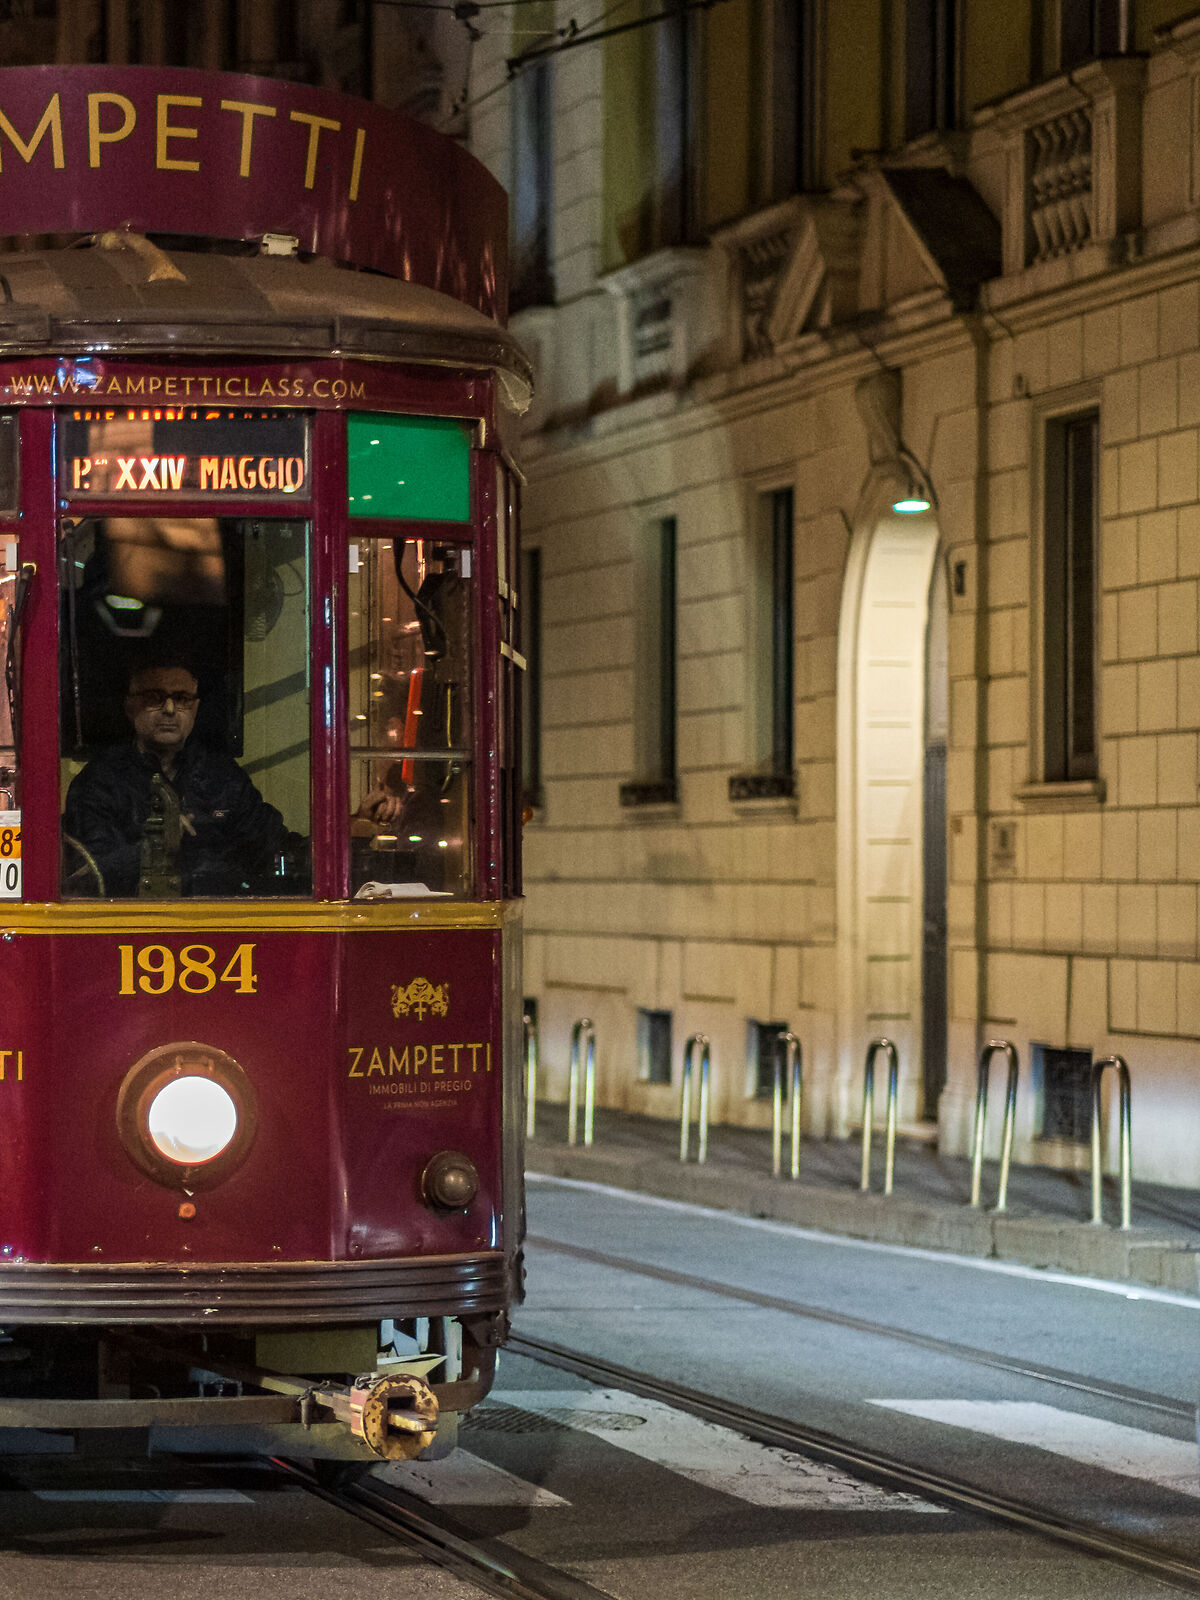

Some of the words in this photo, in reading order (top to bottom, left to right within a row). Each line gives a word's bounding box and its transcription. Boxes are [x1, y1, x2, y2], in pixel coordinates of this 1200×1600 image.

[11, 374, 366, 399] WWW.ZAMPETTICLASS.COM
[115, 456, 185, 490] XXIV
[200, 456, 304, 490] MAGGIO
[118, 943, 258, 995] 1984
[348, 1042, 491, 1078] ZAMPETTI
[369, 1082, 417, 1096] IMMOBILI
[420, 1081, 431, 1094] DI
[434, 1079, 472, 1092] PREGIO
